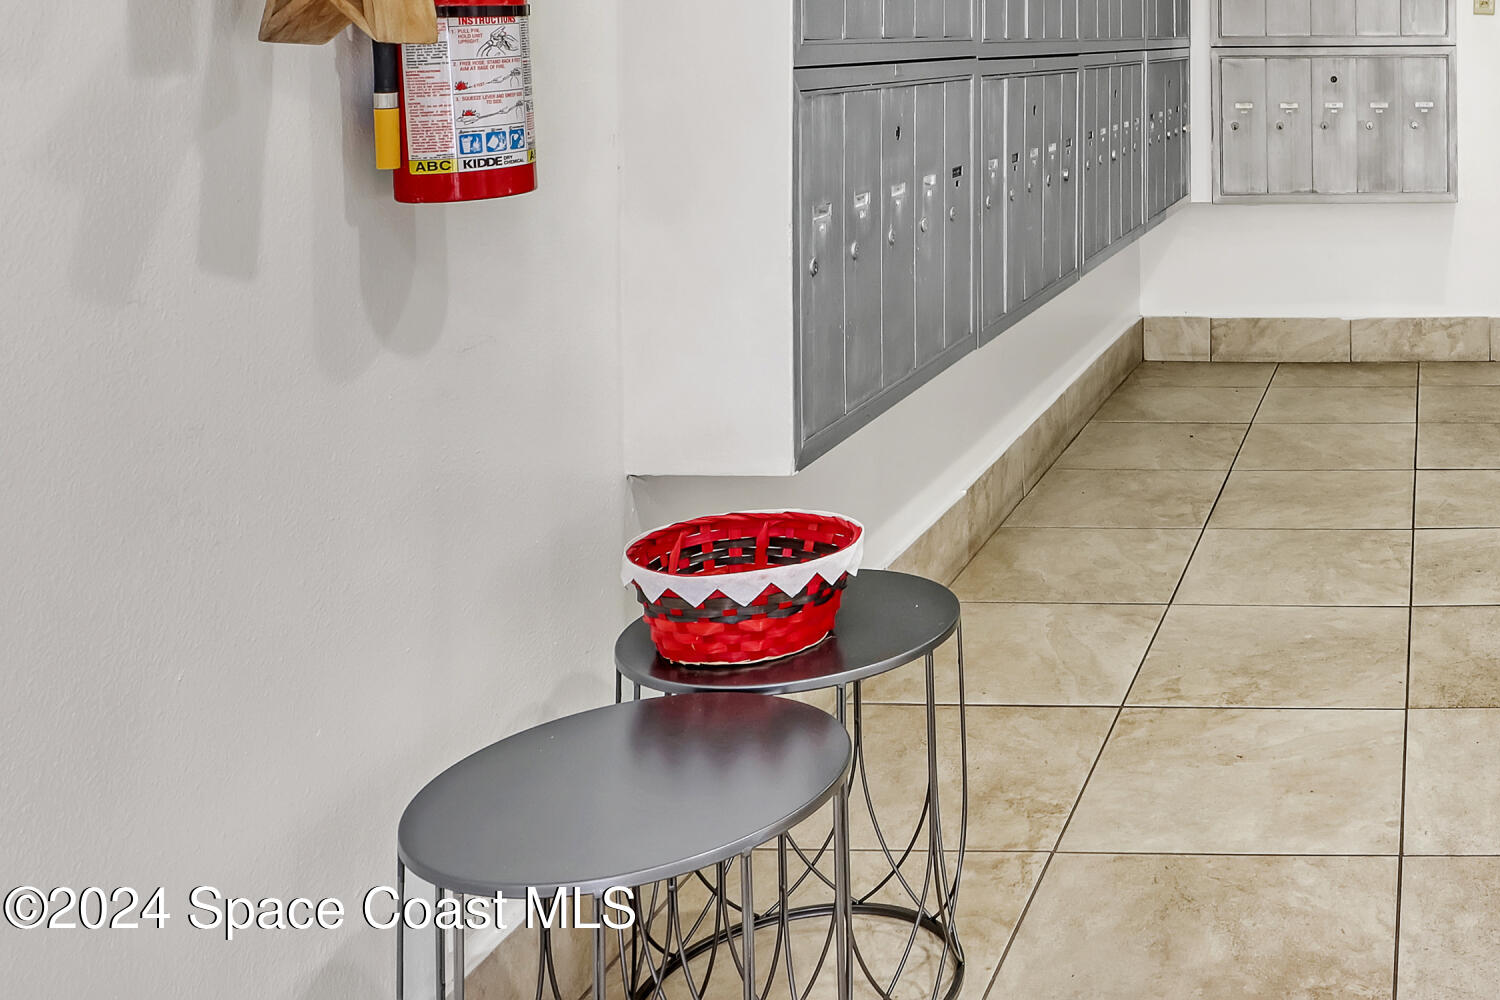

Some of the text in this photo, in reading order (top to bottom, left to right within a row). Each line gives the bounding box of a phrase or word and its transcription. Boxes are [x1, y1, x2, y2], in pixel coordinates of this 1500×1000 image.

[458, 15, 516, 25] INSTRUCTIONS
[416, 160, 452, 171] ABC
[463, 156, 502, 169] KIDDE
